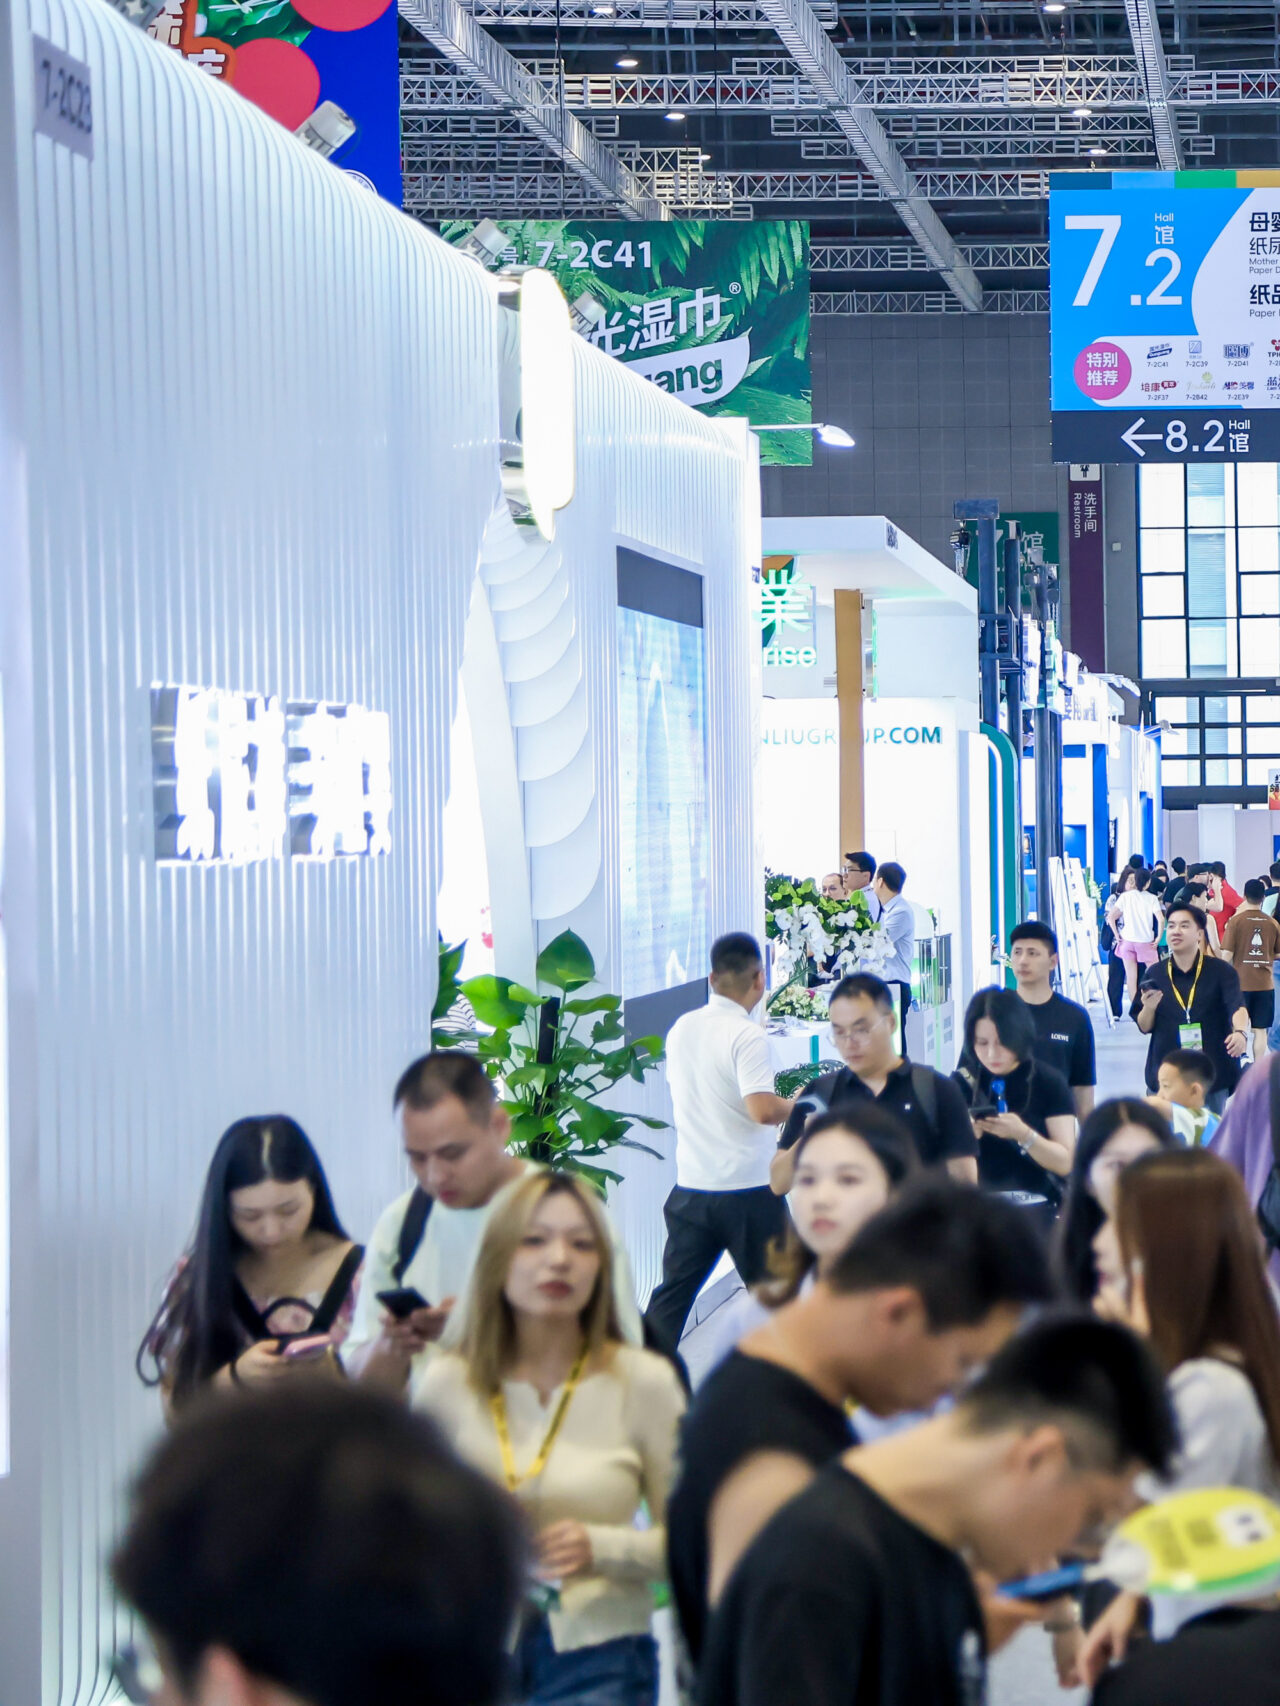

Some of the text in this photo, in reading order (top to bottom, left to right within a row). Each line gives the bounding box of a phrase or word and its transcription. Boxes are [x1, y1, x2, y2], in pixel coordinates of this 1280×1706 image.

[1154, 213, 1174, 222] Hall
[1154, 225, 1175, 245] 馆
[535, 240, 652, 268] 7-2C41
[1249, 257, 1278, 265] Mother
[1249, 266, 1273, 275] Paper
[1249, 309, 1276, 319] Paper
[1086, 352, 1118, 368] 特别
[645, 359, 722, 394] ang
[1086, 370, 1119, 386] 推荐
[1229, 419, 1250, 430] Hall
[1165, 420, 1225, 453] 8.2
[1229, 432, 1250, 453] 馆
[1084, 493, 1097, 533] 洗手间
